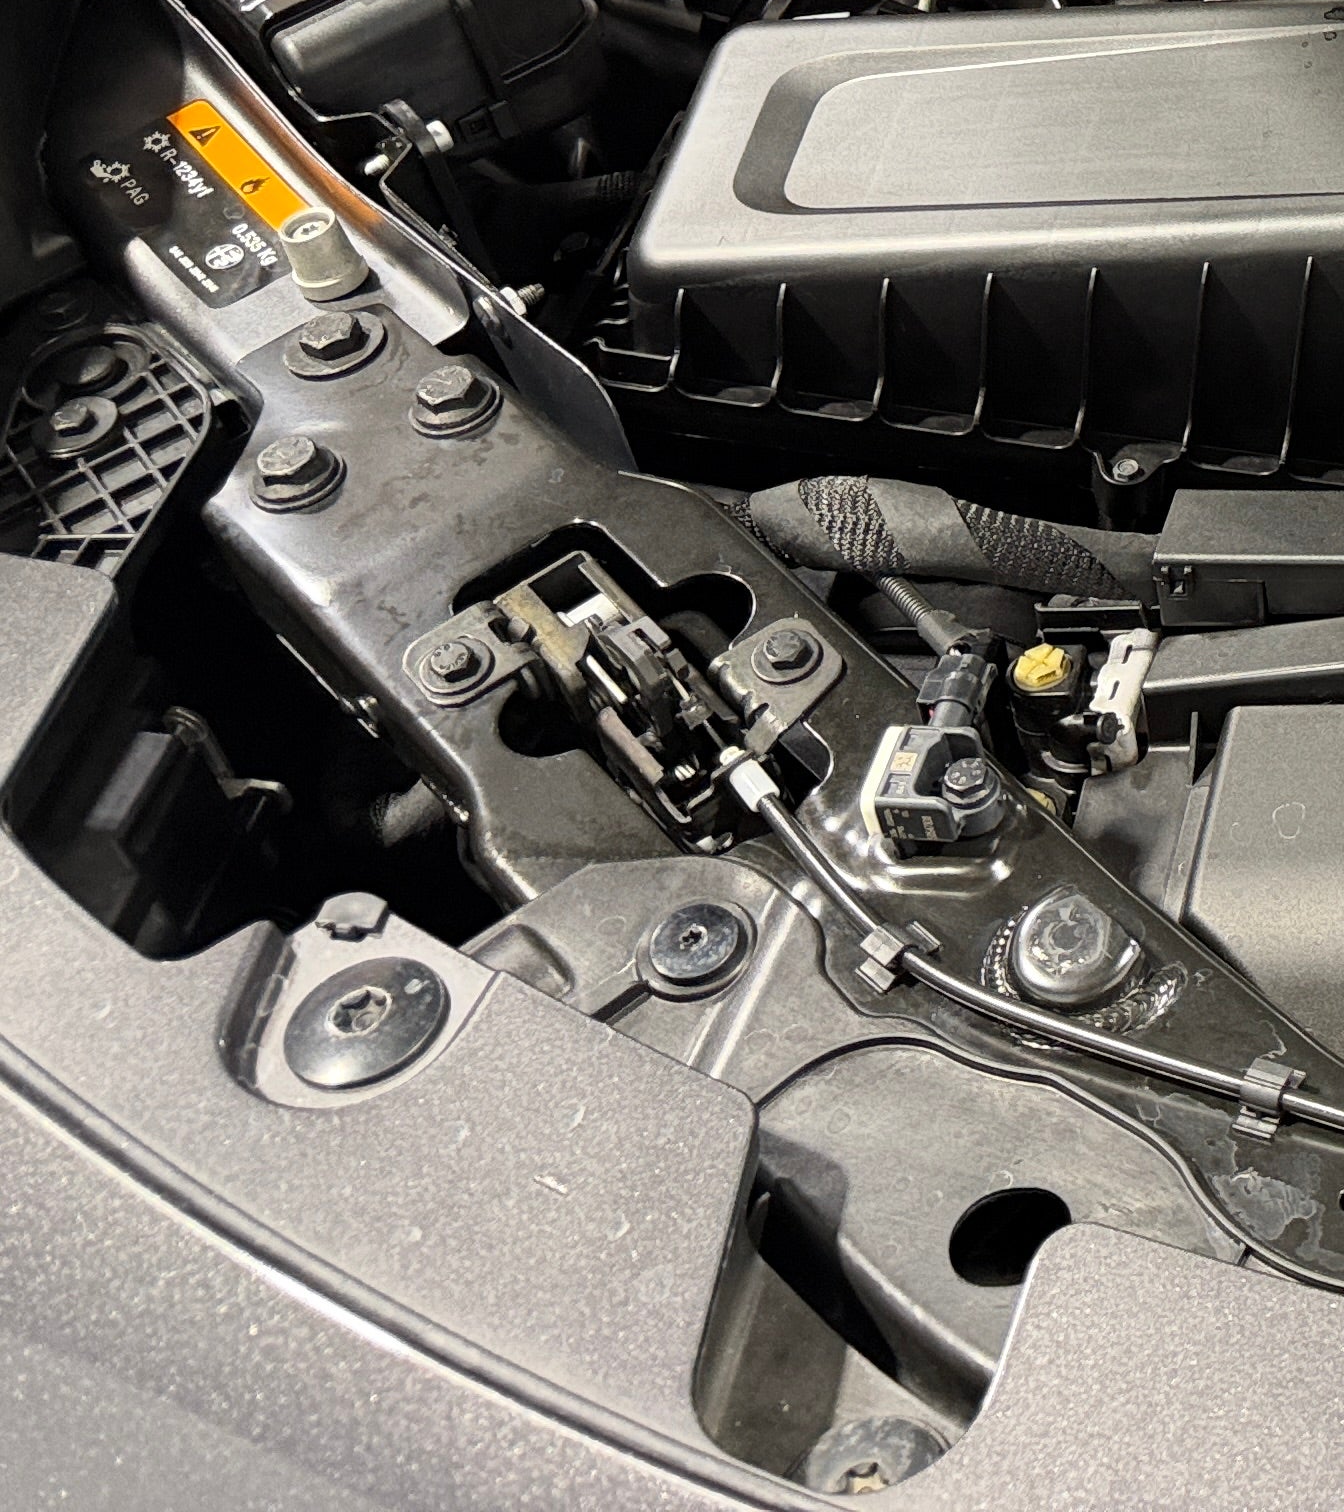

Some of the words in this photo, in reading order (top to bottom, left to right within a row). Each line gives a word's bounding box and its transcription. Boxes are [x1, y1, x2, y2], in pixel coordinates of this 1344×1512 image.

[160, 147, 215, 199] R-1234yf
[120, 178, 150, 206] PAG
[257, 247, 279, 267] Kg
